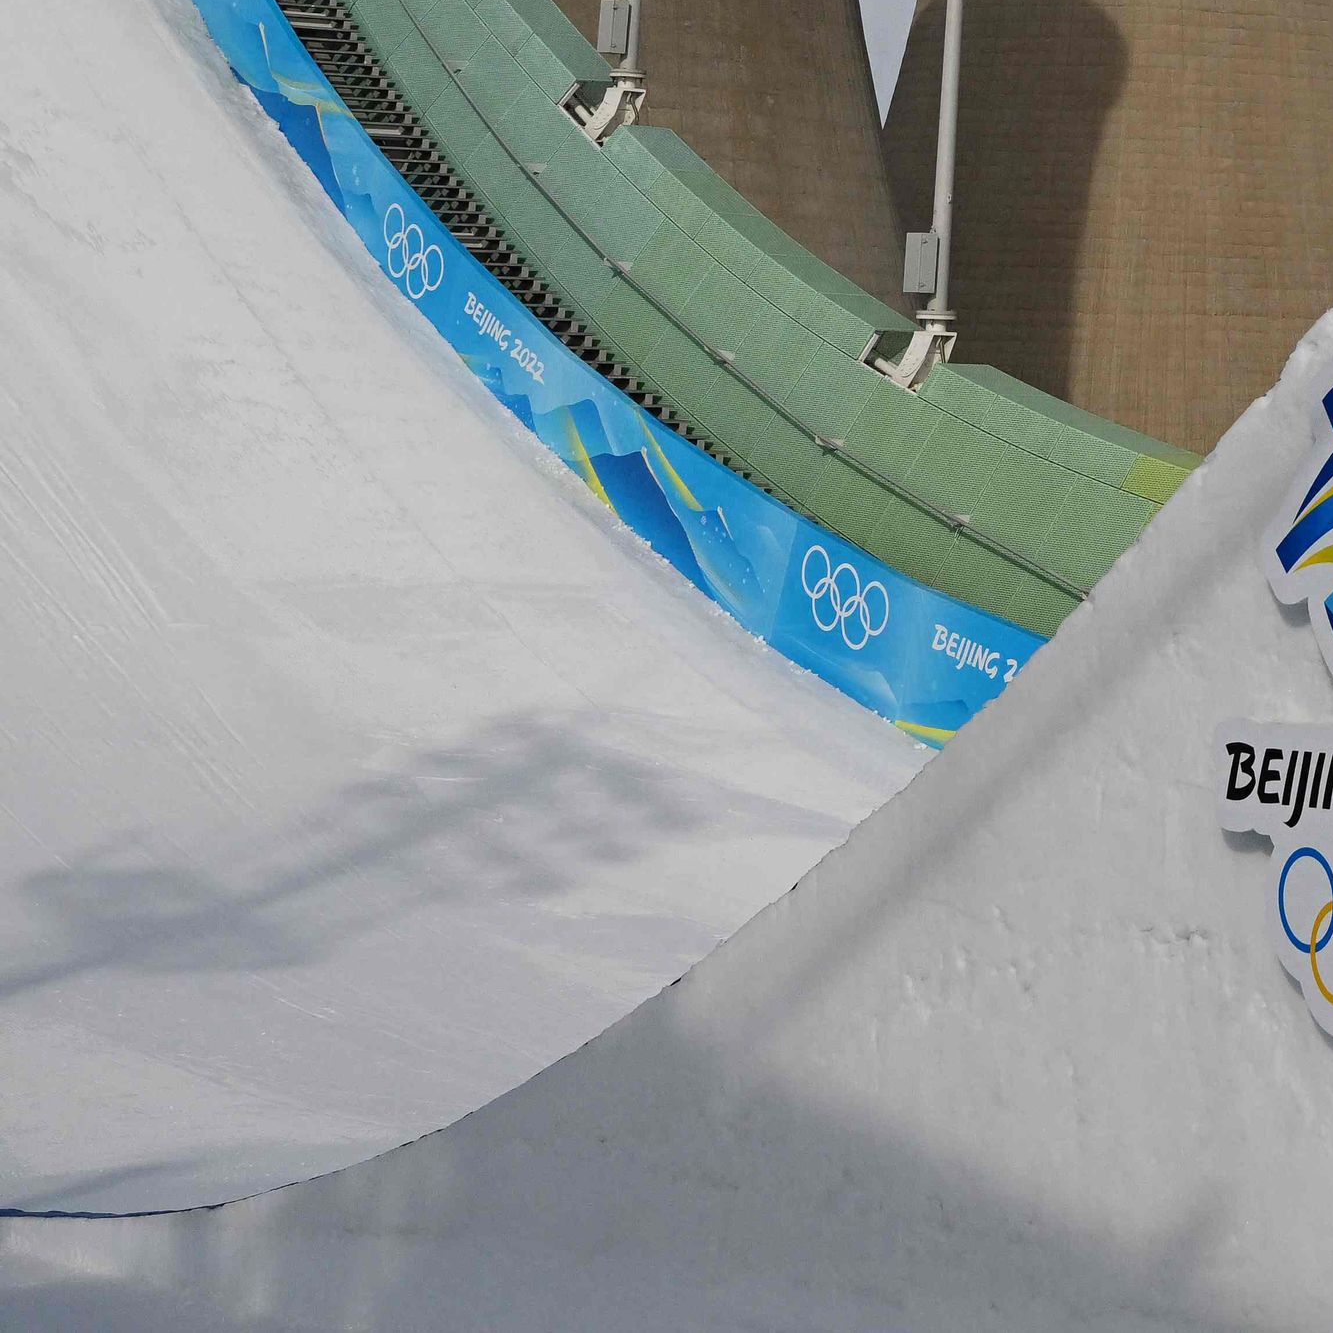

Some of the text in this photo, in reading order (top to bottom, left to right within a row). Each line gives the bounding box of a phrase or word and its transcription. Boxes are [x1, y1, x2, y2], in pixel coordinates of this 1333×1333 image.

[463, 291, 545, 385] BEIJING 2022
[931, 624, 1001, 679] BEIJING
